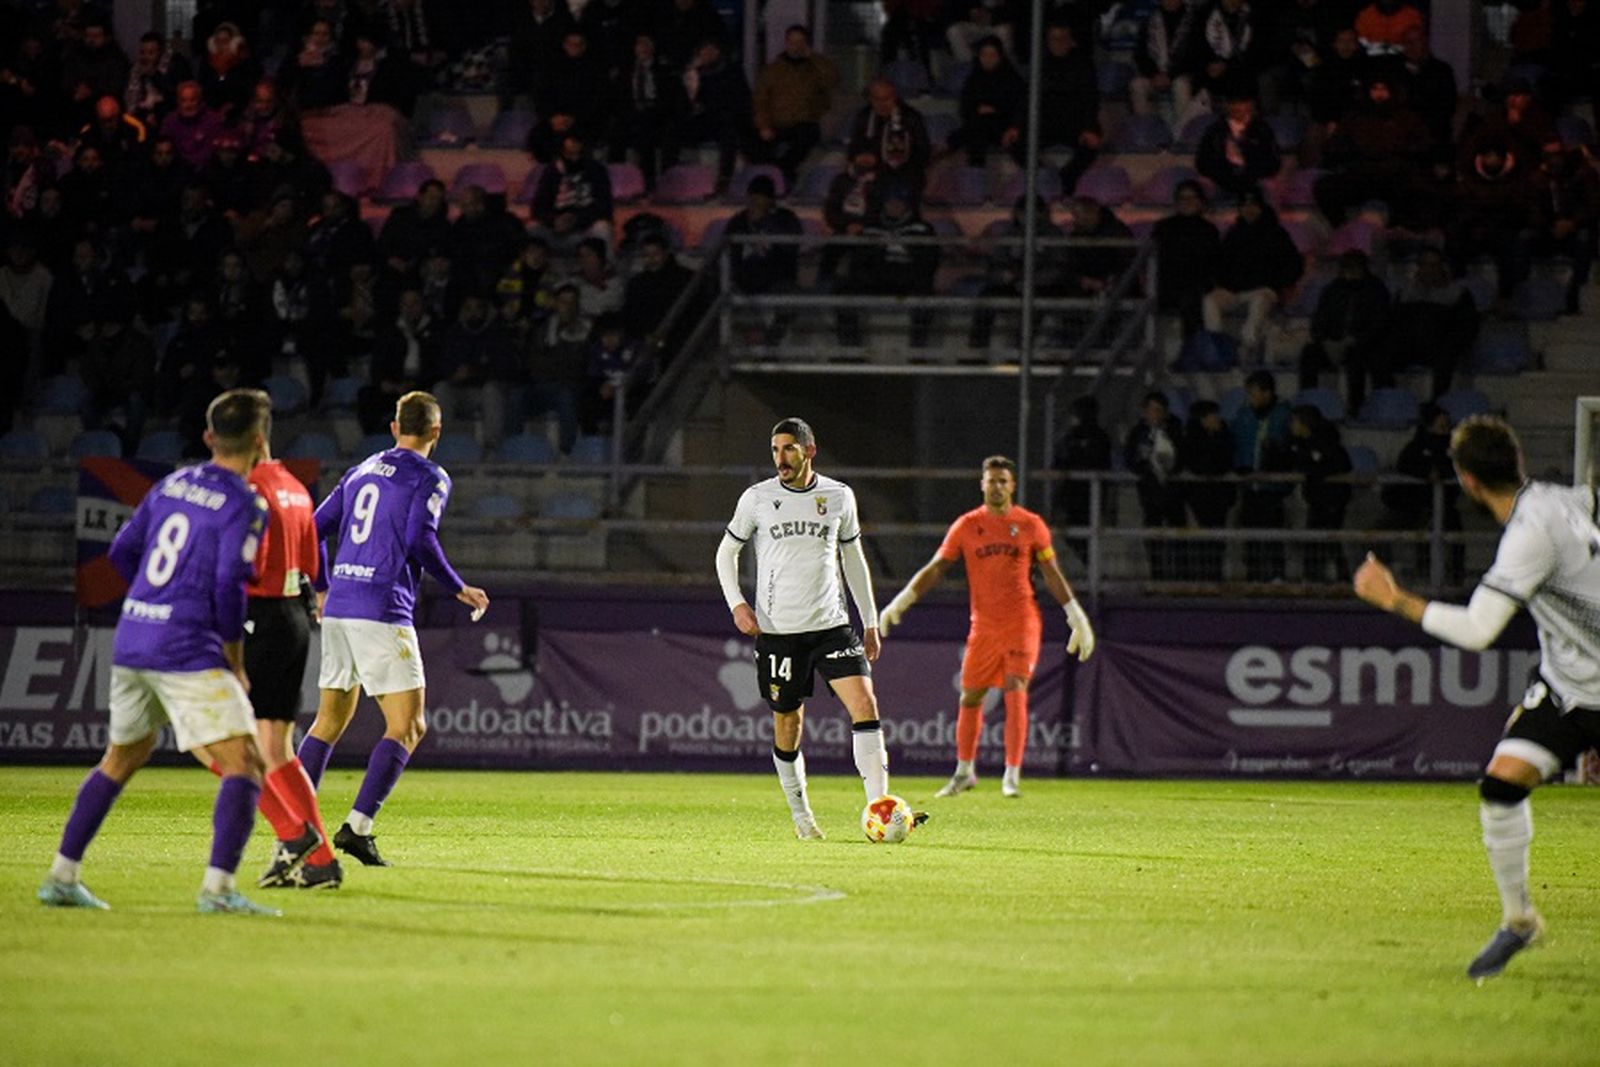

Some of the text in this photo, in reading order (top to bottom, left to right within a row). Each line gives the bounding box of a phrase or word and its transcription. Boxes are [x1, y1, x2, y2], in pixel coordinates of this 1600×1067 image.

[350, 482, 381, 545] 9
[769, 520, 830, 541] CEUTA
[145, 512, 190, 587] 8
[975, 543, 1020, 559] CEUTA
[768, 653, 793, 682] 14
[425, 699, 614, 736] odoactiva
[638, 704, 849, 752] podoacva
[880, 712, 1081, 747] odciva
